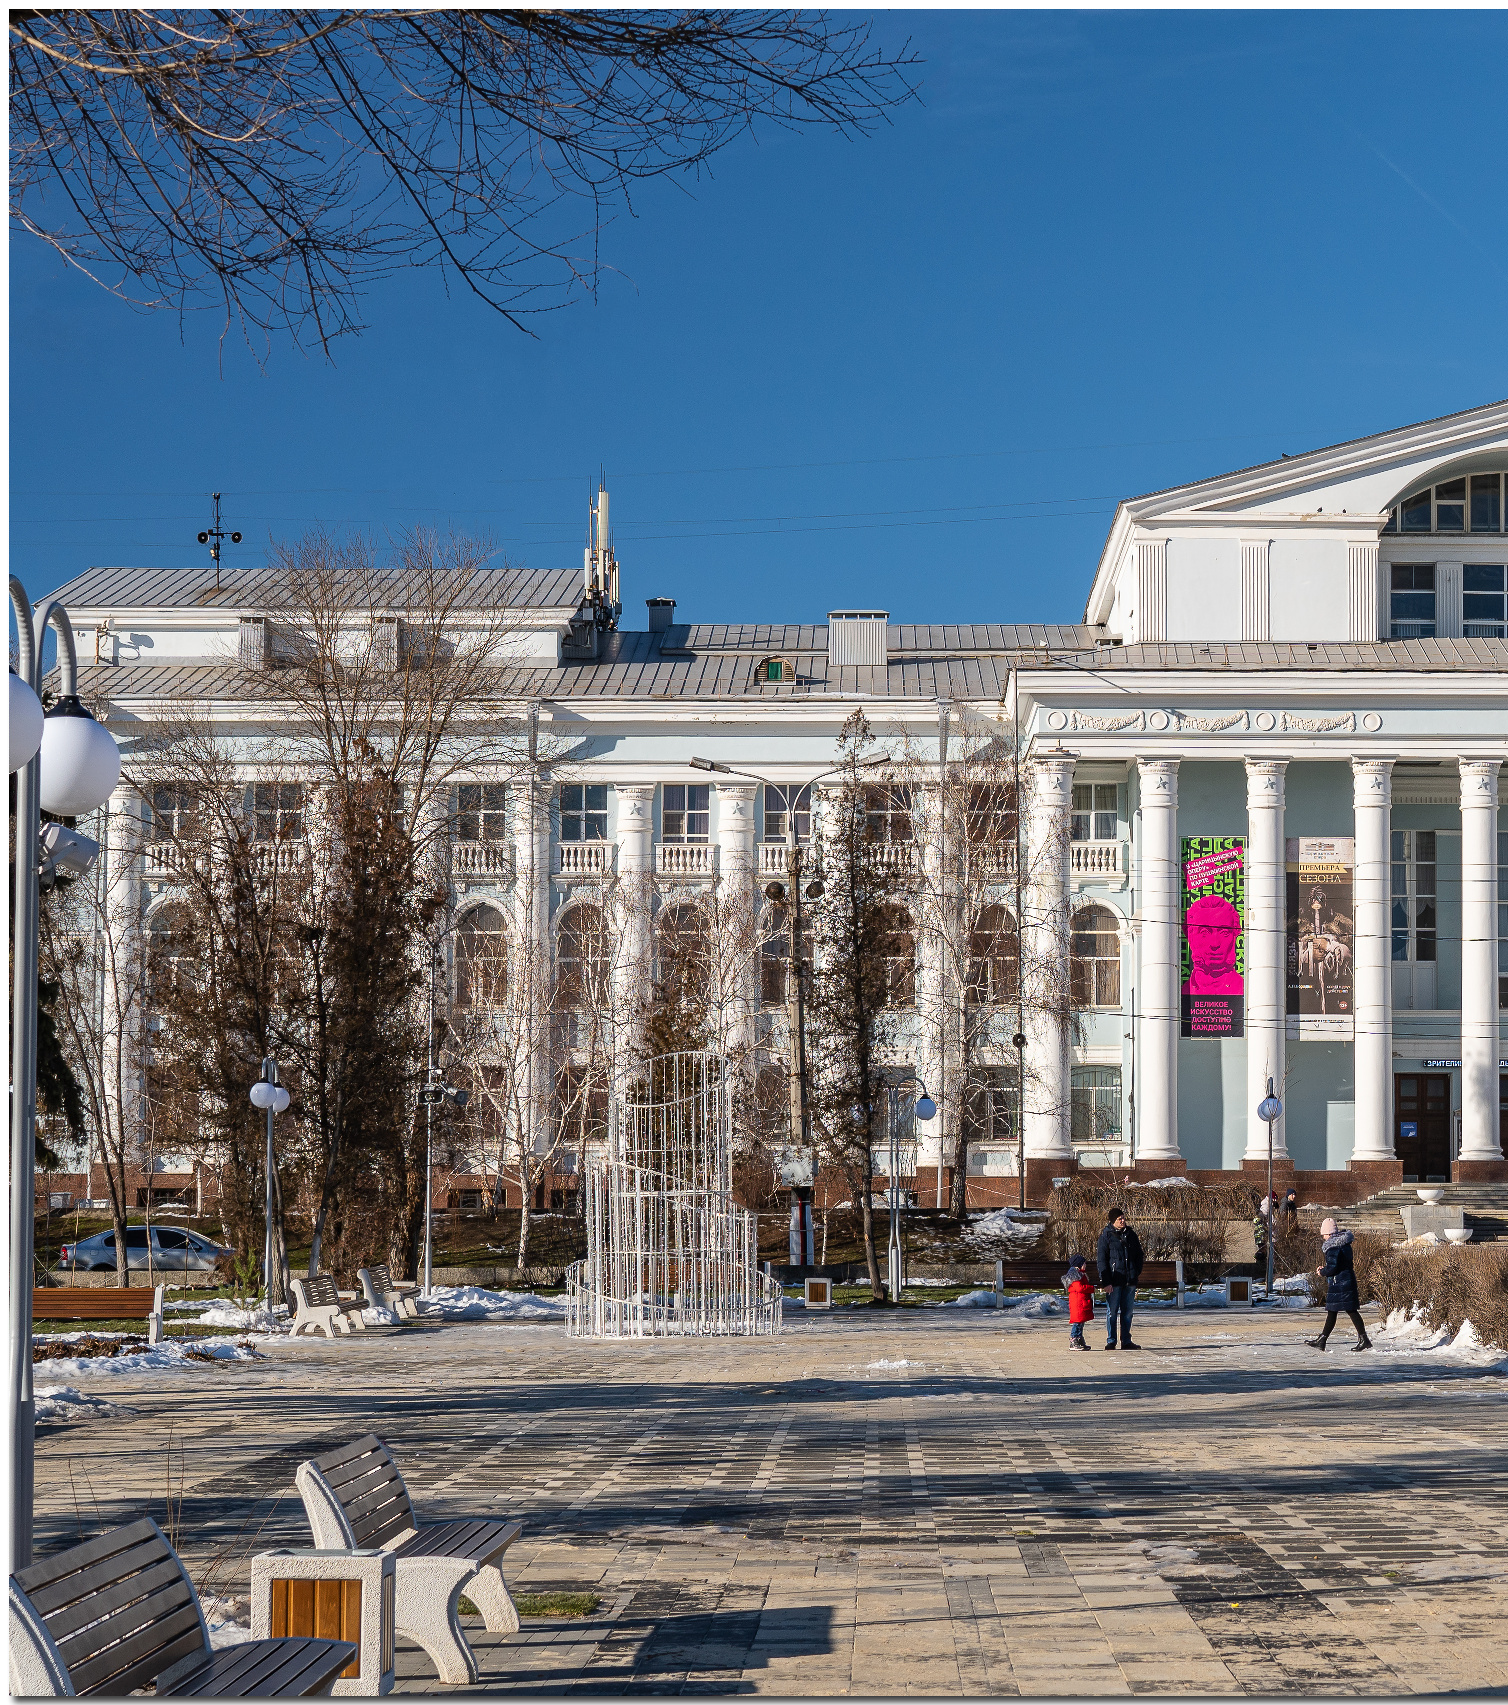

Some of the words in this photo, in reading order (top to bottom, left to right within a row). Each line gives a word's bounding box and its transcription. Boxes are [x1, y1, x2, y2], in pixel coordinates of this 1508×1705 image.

[1198, 861, 1239, 879] ПУШКИНСКОЙ
[1190, 877, 1210, 887] КАРТЕ
[1299, 874, 1341, 883] СЕЗОНА
